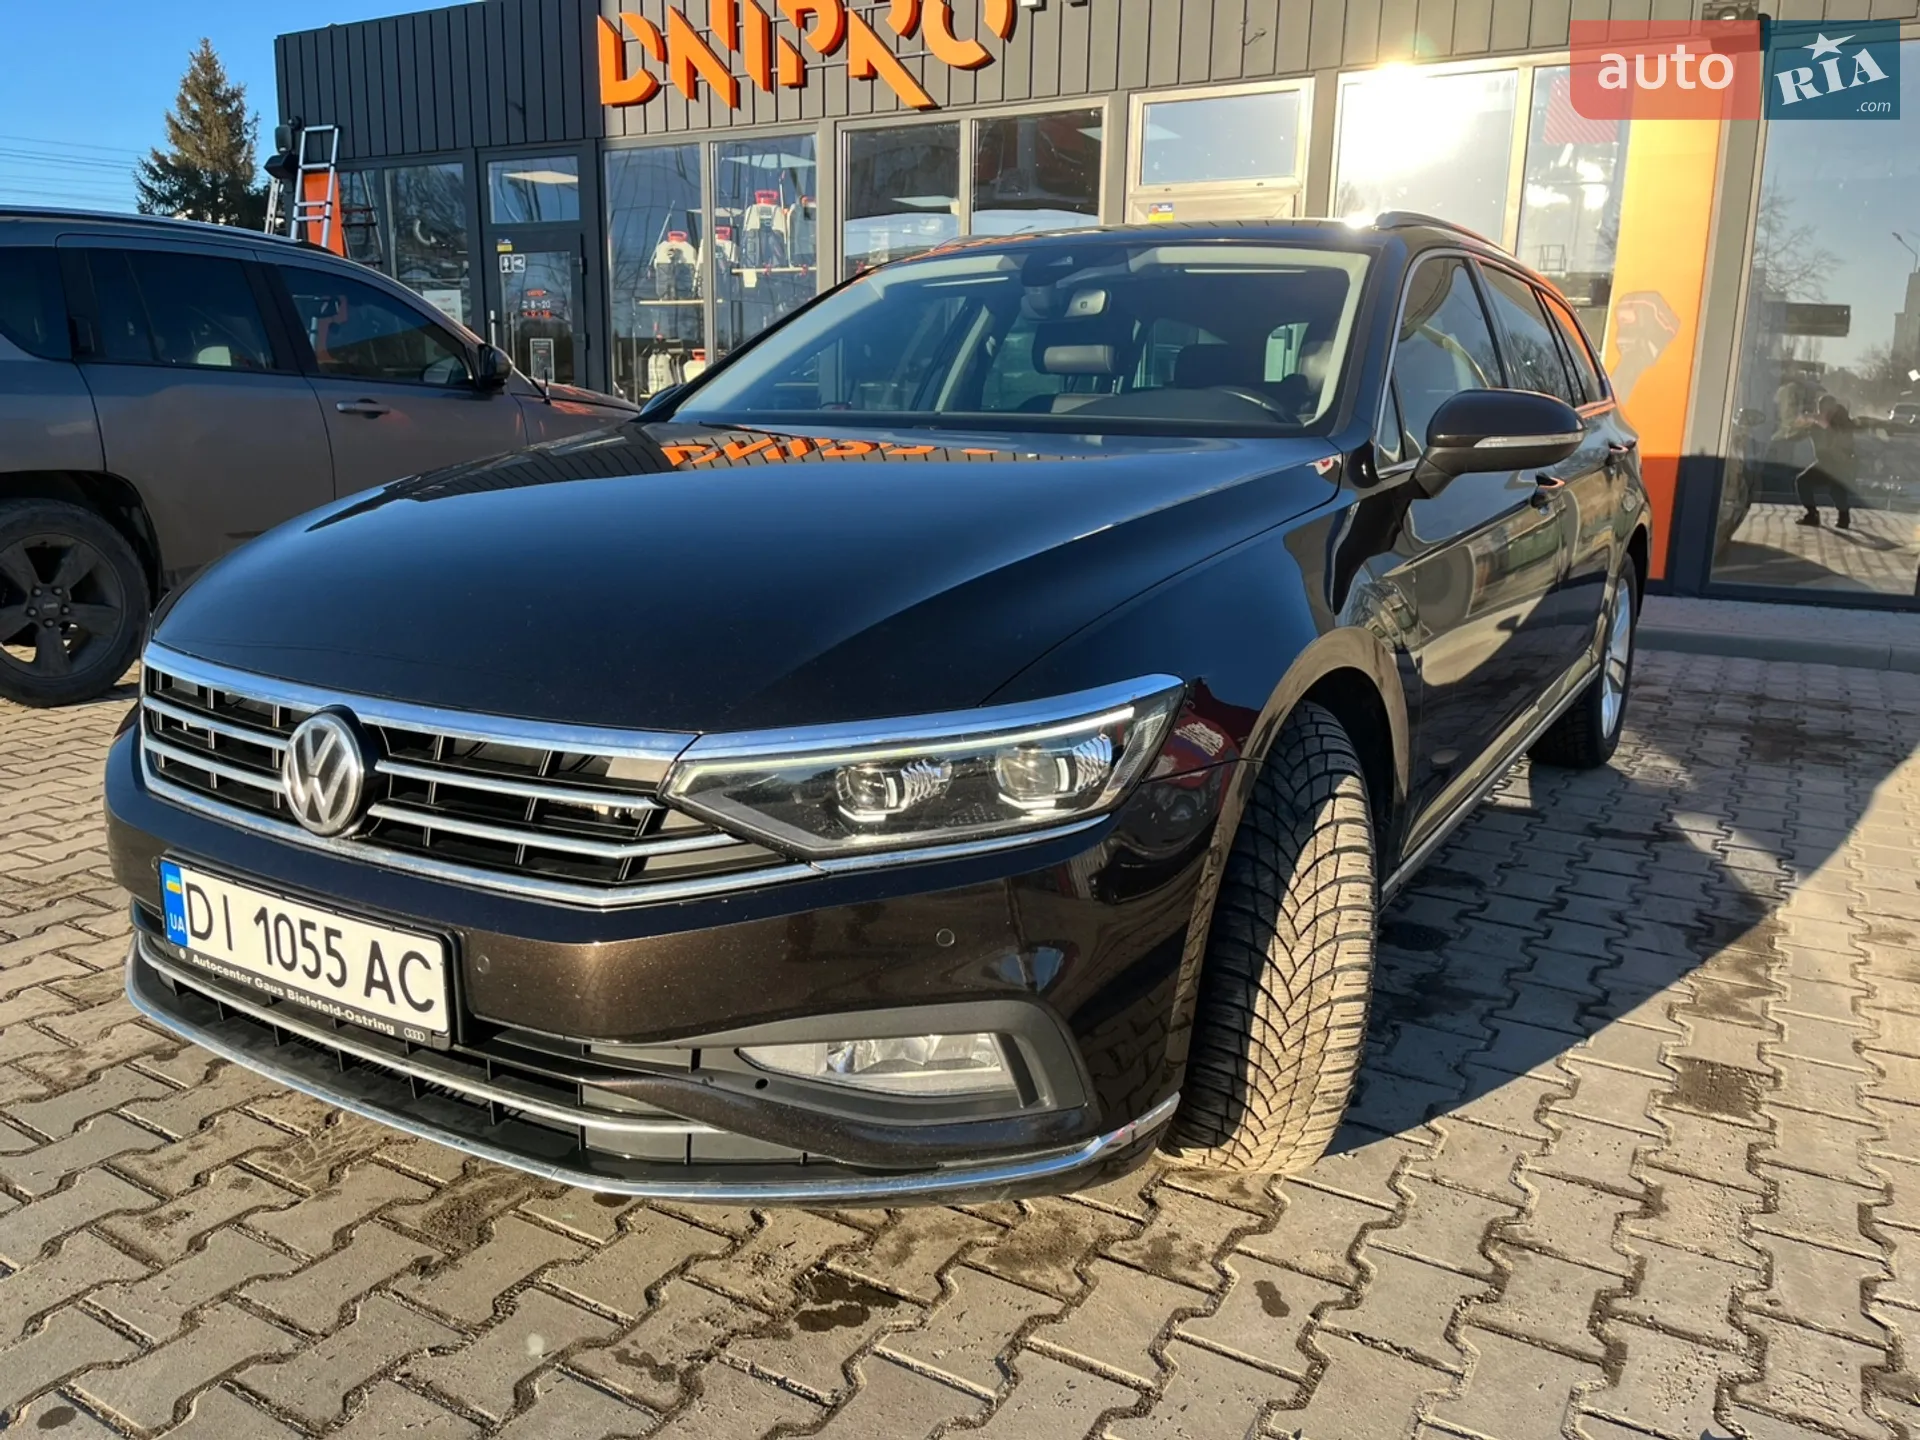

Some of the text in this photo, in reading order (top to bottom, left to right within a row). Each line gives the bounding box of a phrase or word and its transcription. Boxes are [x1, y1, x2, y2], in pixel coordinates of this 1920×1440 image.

[169, 912, 186, 934] UA
[185, 882, 435, 1013] DI 1055 AC
[192, 954, 395, 1036] Autocenter Gaus Bielefeld-Ostring
